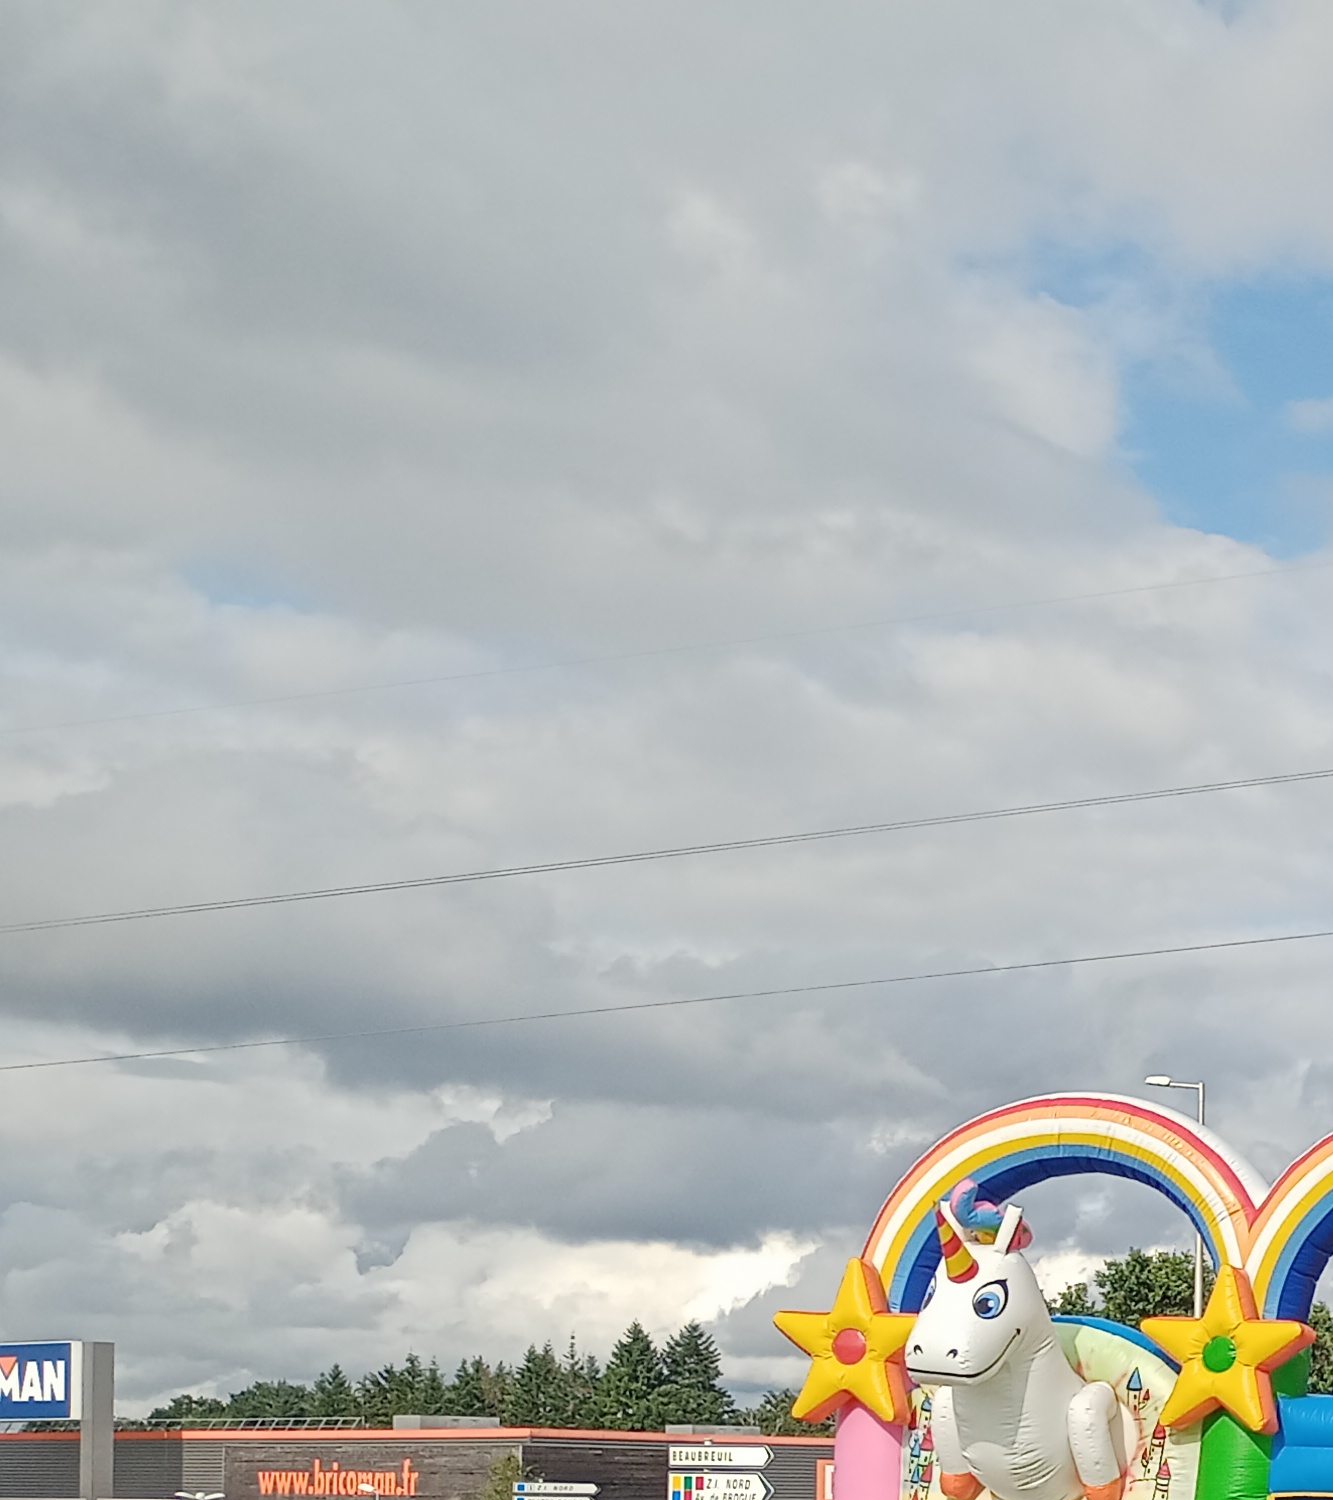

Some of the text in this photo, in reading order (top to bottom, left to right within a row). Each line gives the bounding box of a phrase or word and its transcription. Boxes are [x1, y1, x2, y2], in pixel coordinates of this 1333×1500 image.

[672, 1450, 733, 1461] BEAUBREUIL
[258, 1458, 419, 1496] www.bricoman.fr
[726, 1479, 751, 1490] NORD
